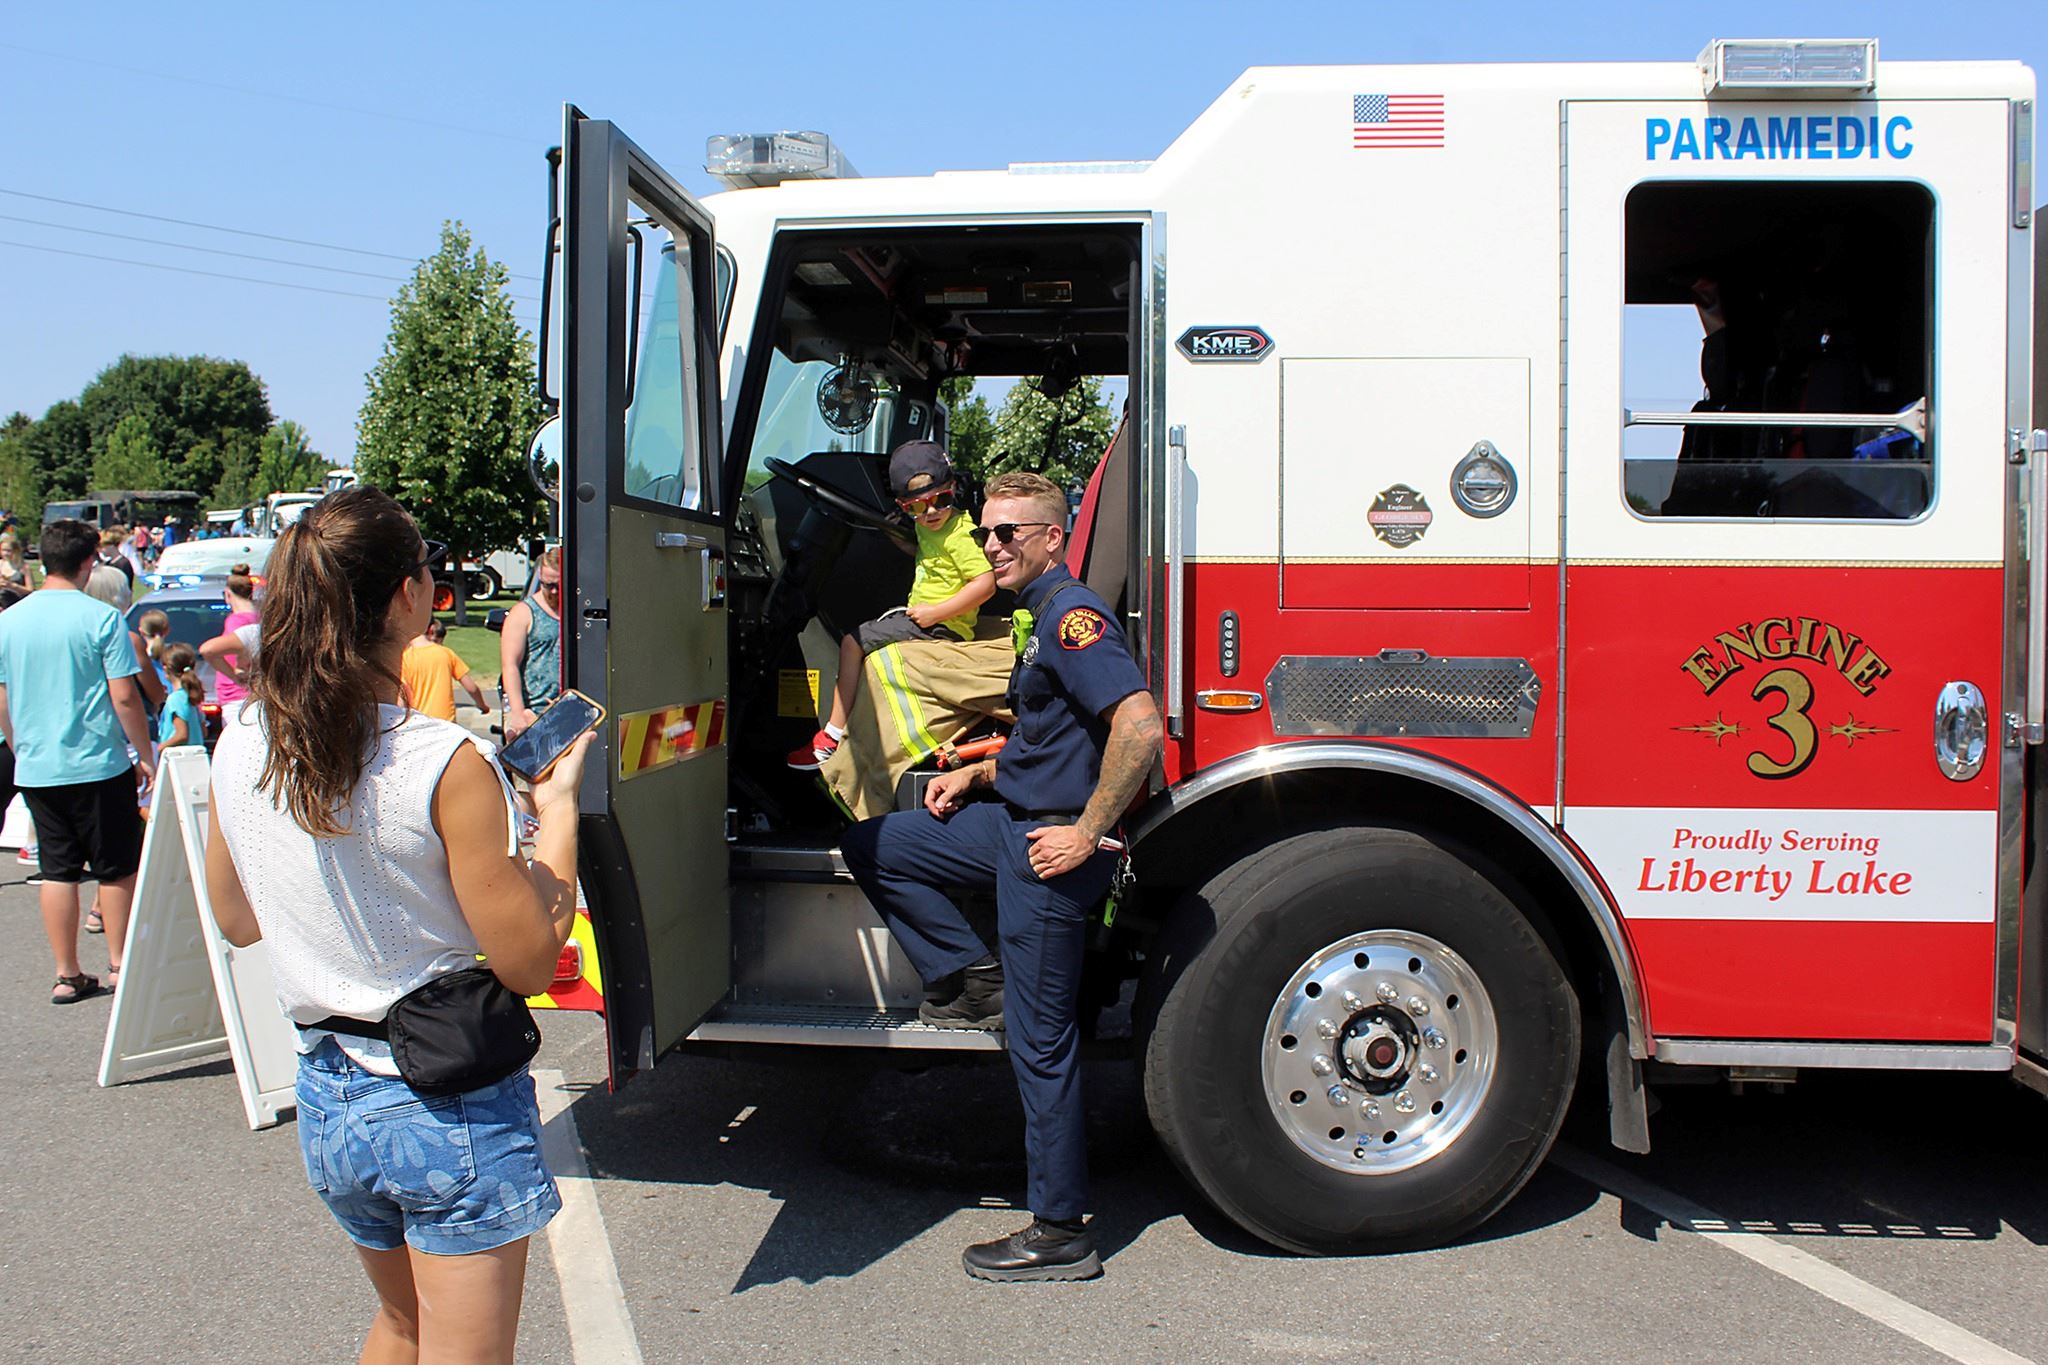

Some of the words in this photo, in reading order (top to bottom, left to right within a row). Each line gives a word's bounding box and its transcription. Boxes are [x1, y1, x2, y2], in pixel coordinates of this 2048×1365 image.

[1646, 115, 1914, 161] PARAMEDIC
[1192, 336, 1252, 349] KME
[1681, 616, 1892, 697] ENGINE
[1747, 668, 1819, 780] 3
[1673, 828, 1773, 854] Proudly
[1780, 829, 1880, 856] Serving
[1637, 857, 1793, 901] Liberty
[1807, 860, 1913, 896] Lake
